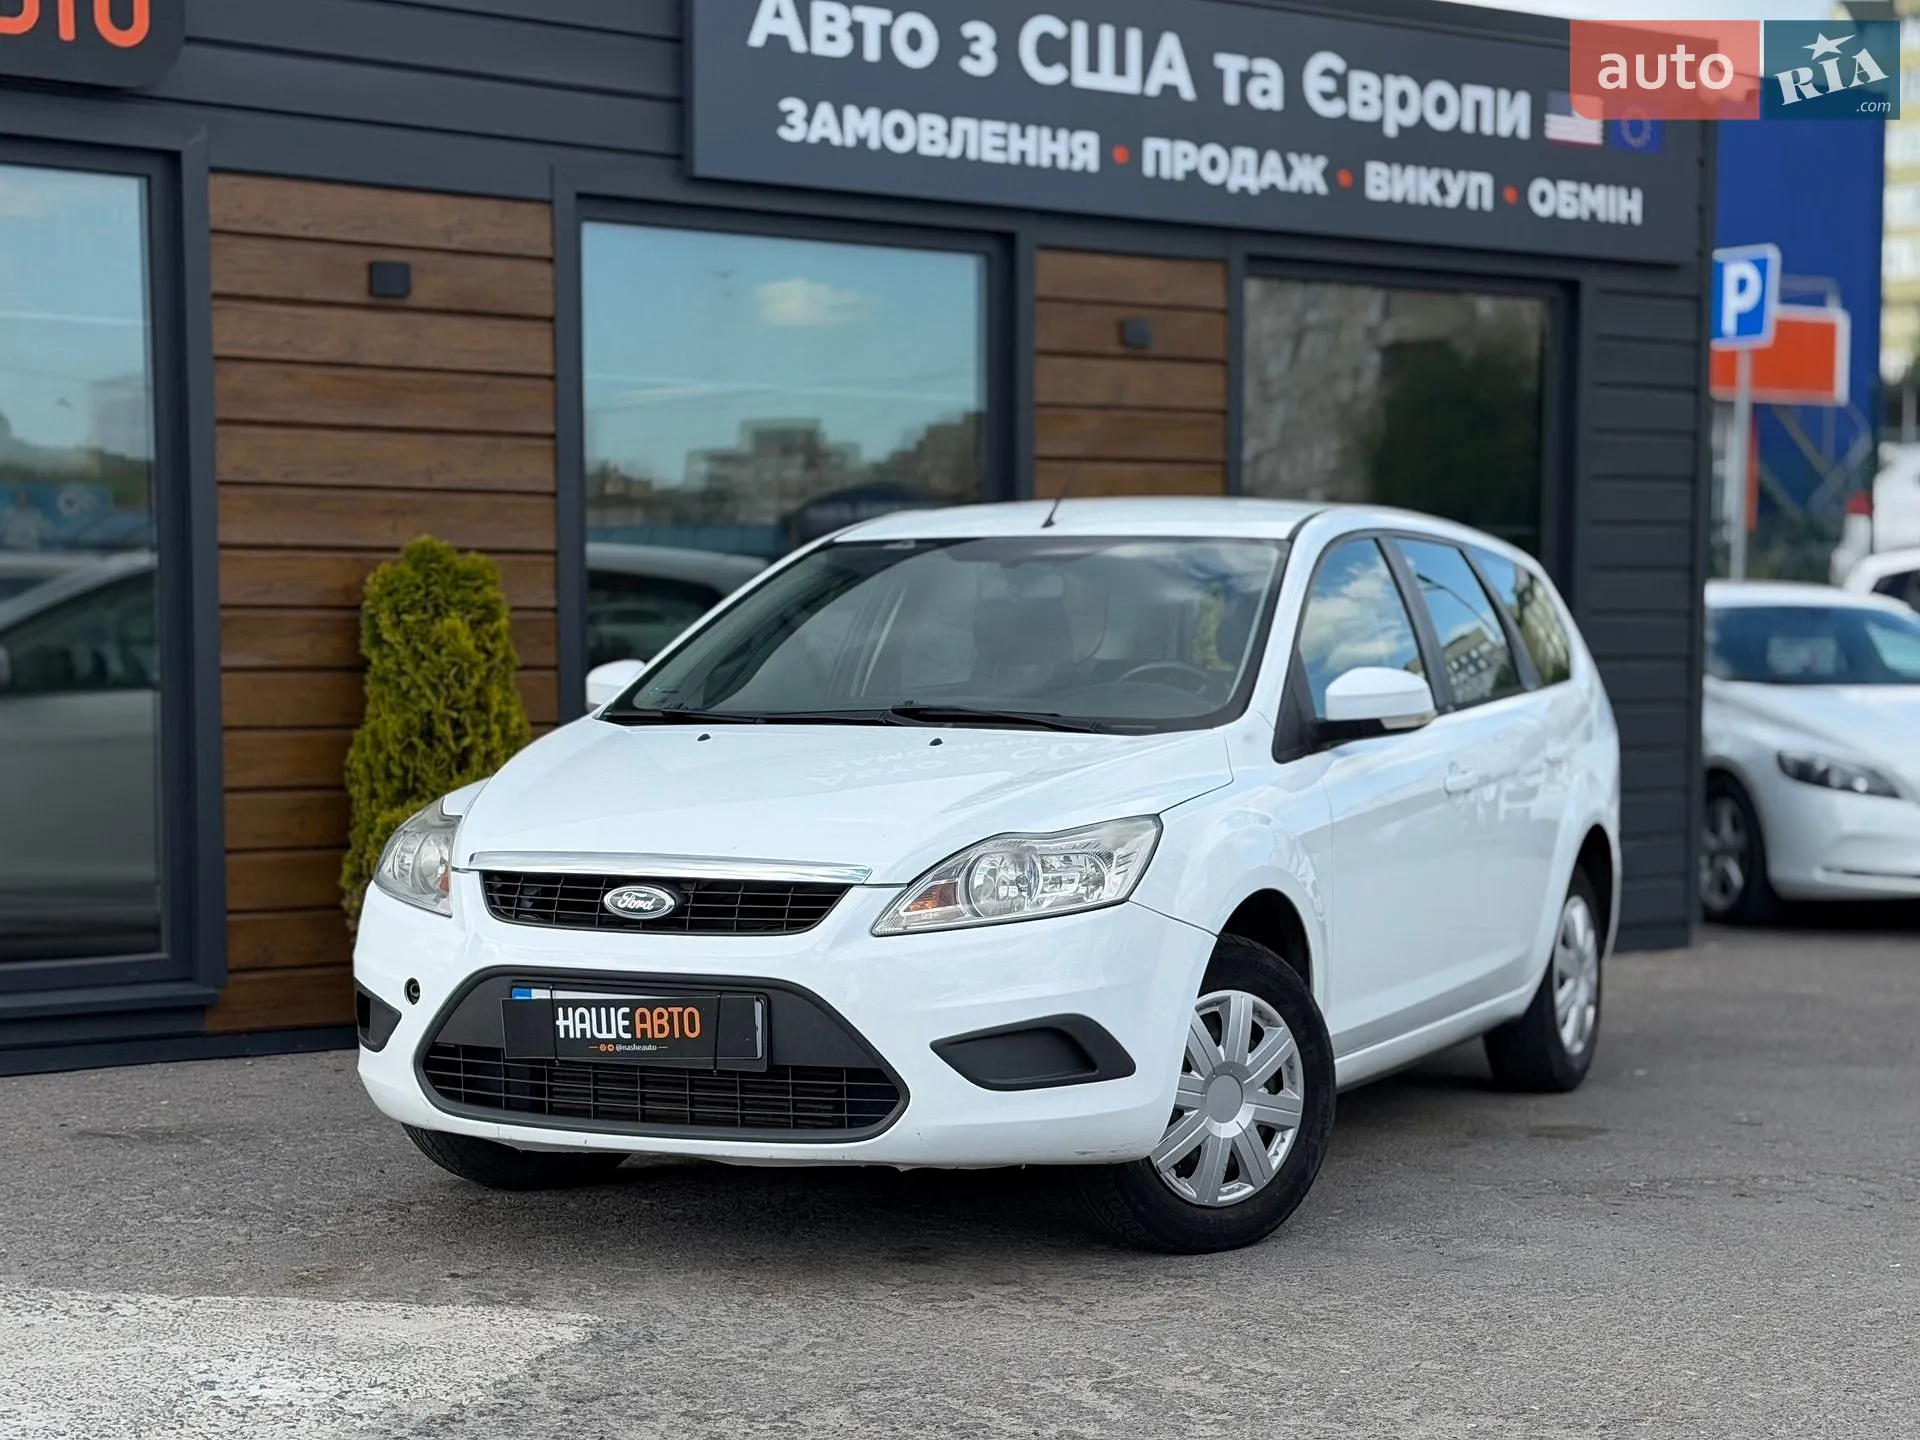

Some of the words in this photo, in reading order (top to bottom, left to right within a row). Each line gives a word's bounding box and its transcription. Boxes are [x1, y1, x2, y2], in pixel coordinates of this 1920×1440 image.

[747, 0, 940, 69] Авто
[1018, 14, 1197, 101] США
[1212, 51, 1286, 111] та
[1302, 50, 1531, 140] Європи
[777, 97, 1100, 173] ЗАМОВЛЕННЯ
[1141, 136, 1329, 195] ПРОДАЖ
[1364, 160, 1494, 212] ВИКУП
[1527, 177, 1643, 226] ОБМІН
[1722, 258, 1764, 337] P
[617, 891, 656, 911] Ford
[556, 1006, 632, 1039] НАШЕ
[634, 1006, 701, 1039] АВТО
[615, 1043, 657, 1052] @nasheauto
